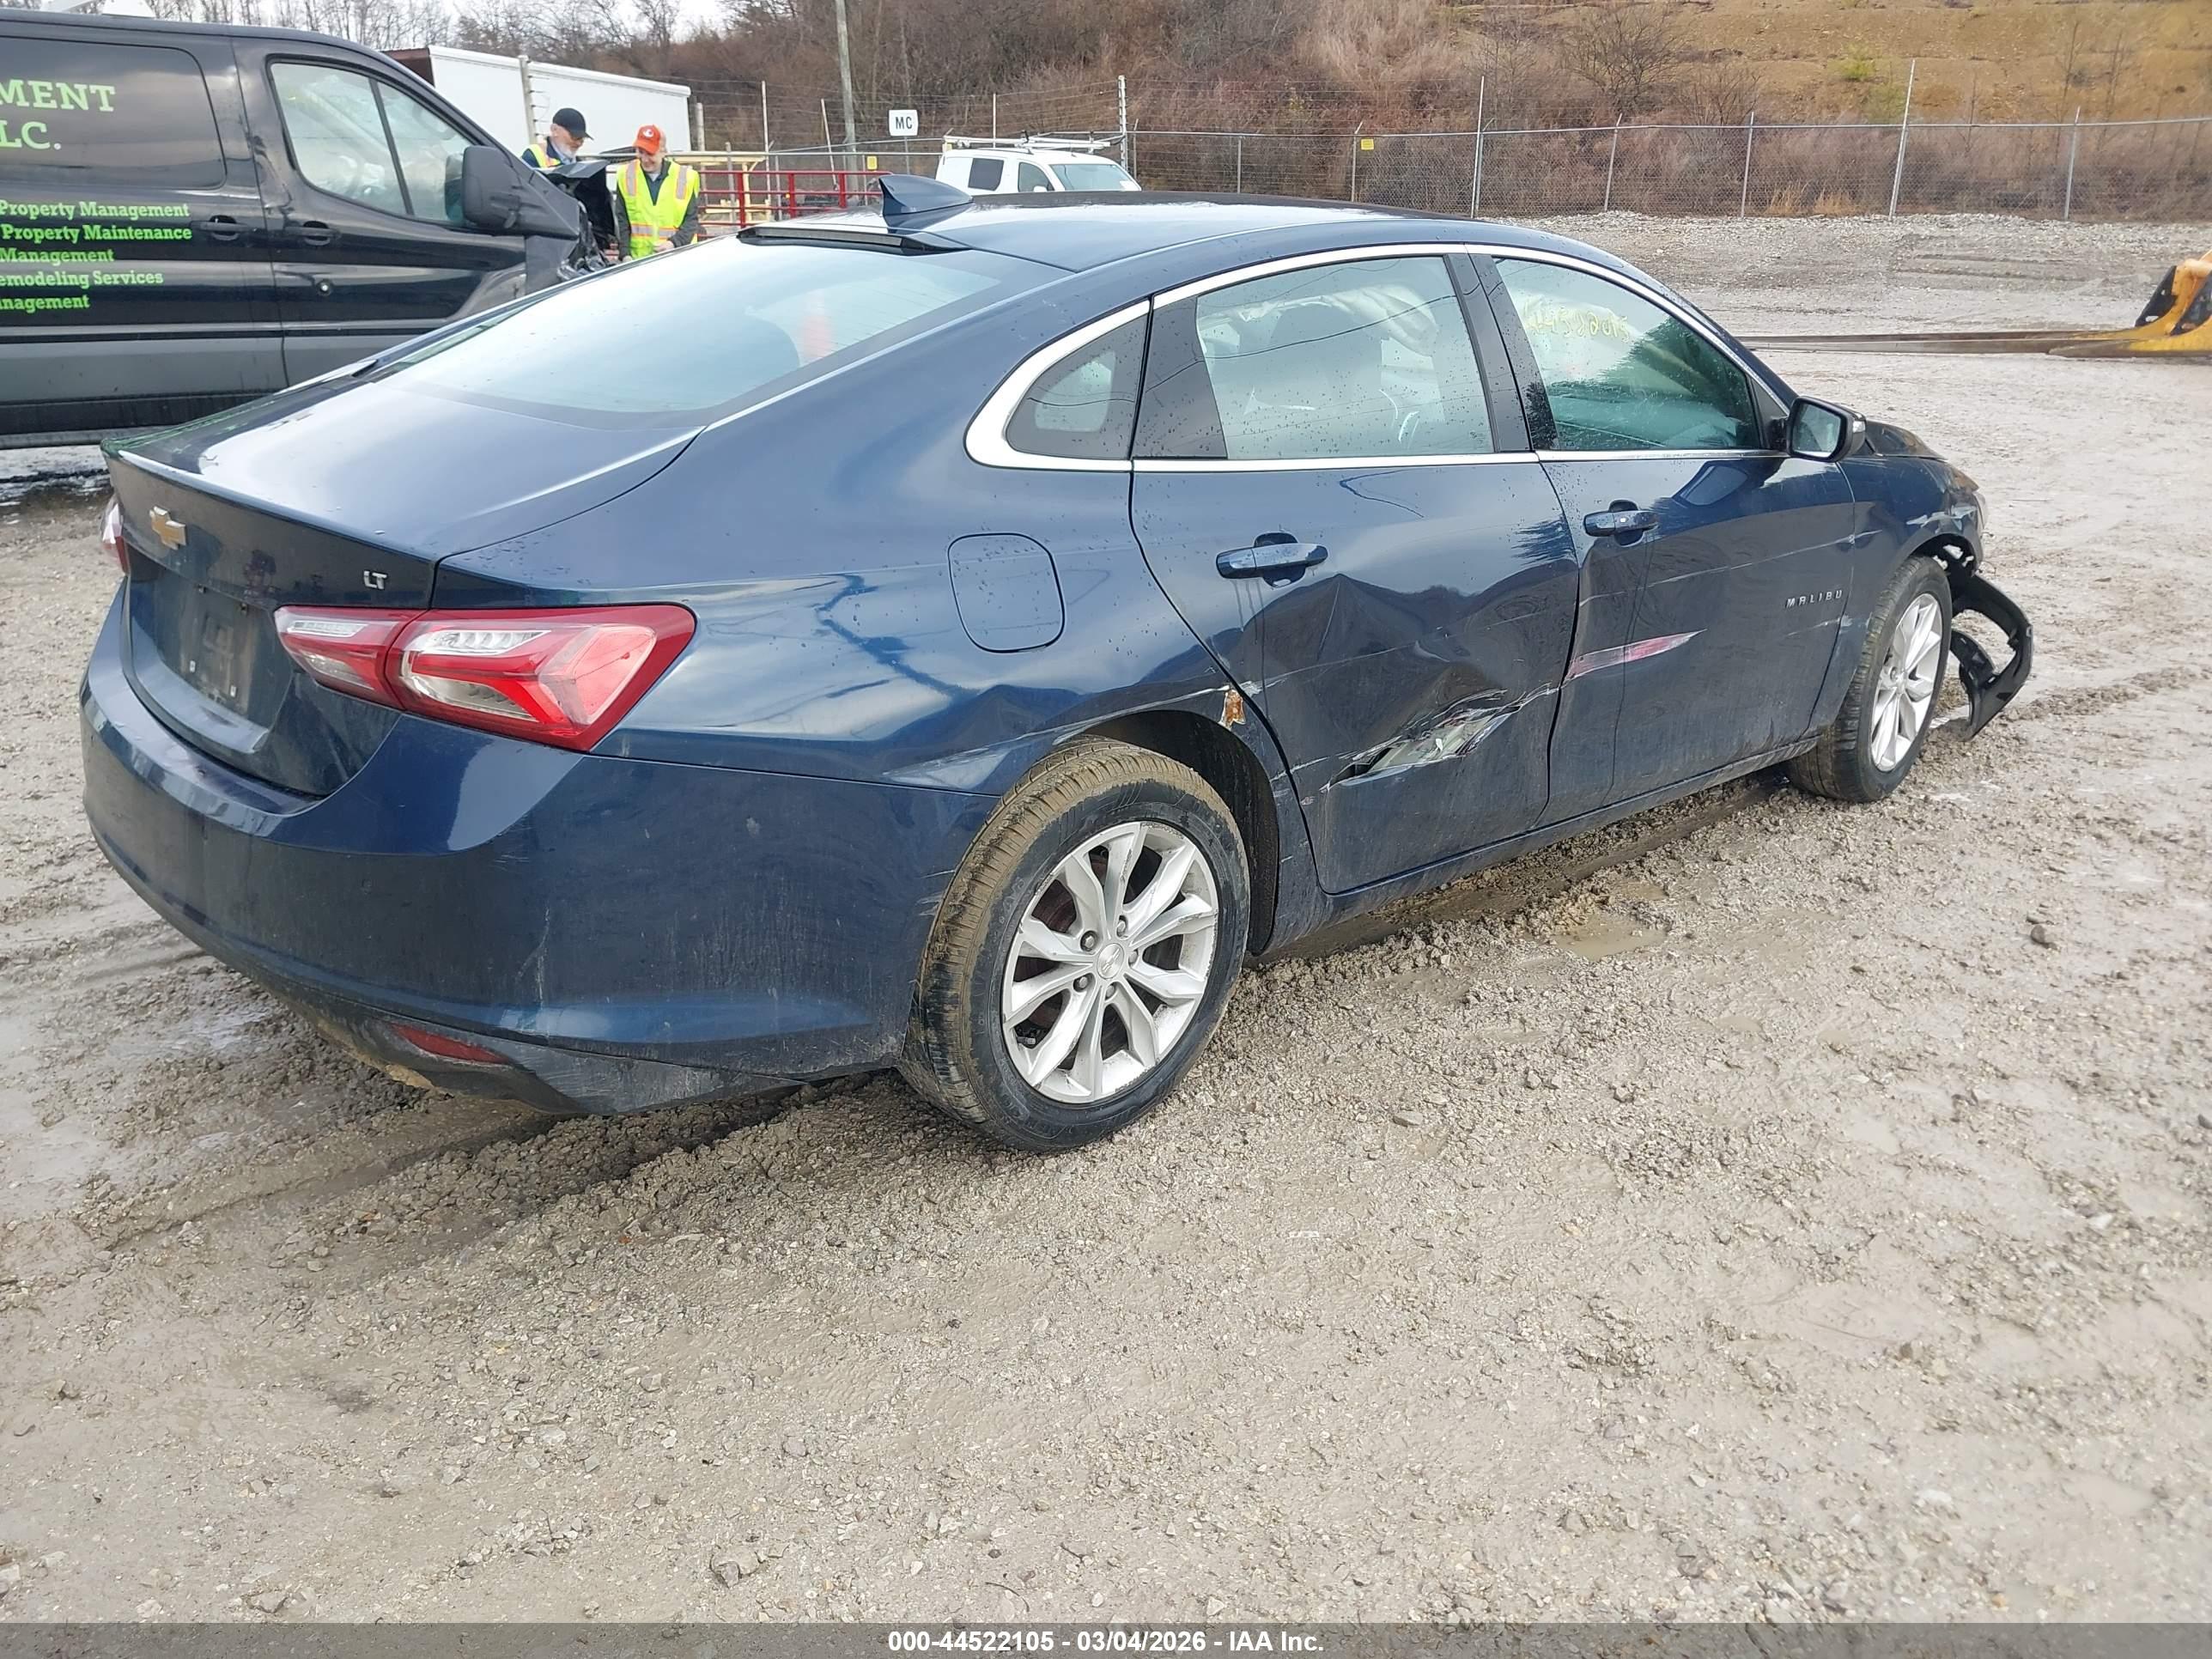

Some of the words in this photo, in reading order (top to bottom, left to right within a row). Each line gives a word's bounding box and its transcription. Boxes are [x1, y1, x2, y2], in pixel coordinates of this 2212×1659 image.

[0, 79, 115, 112] MENT
[895, 116, 913, 130] MC
[0, 199, 76, 220] Property
[79, 202, 190, 221] Management
[1, 223, 80, 244] Property
[82, 225, 192, 240] Maintenance
[0, 246, 115, 266] Management
[0, 270, 89, 289] emodeling
[92, 270, 164, 285] Services
[0, 295, 90, 313] nagement
[363, 570, 387, 590] LT
[1786, 589, 1843, 608] MALIBU
